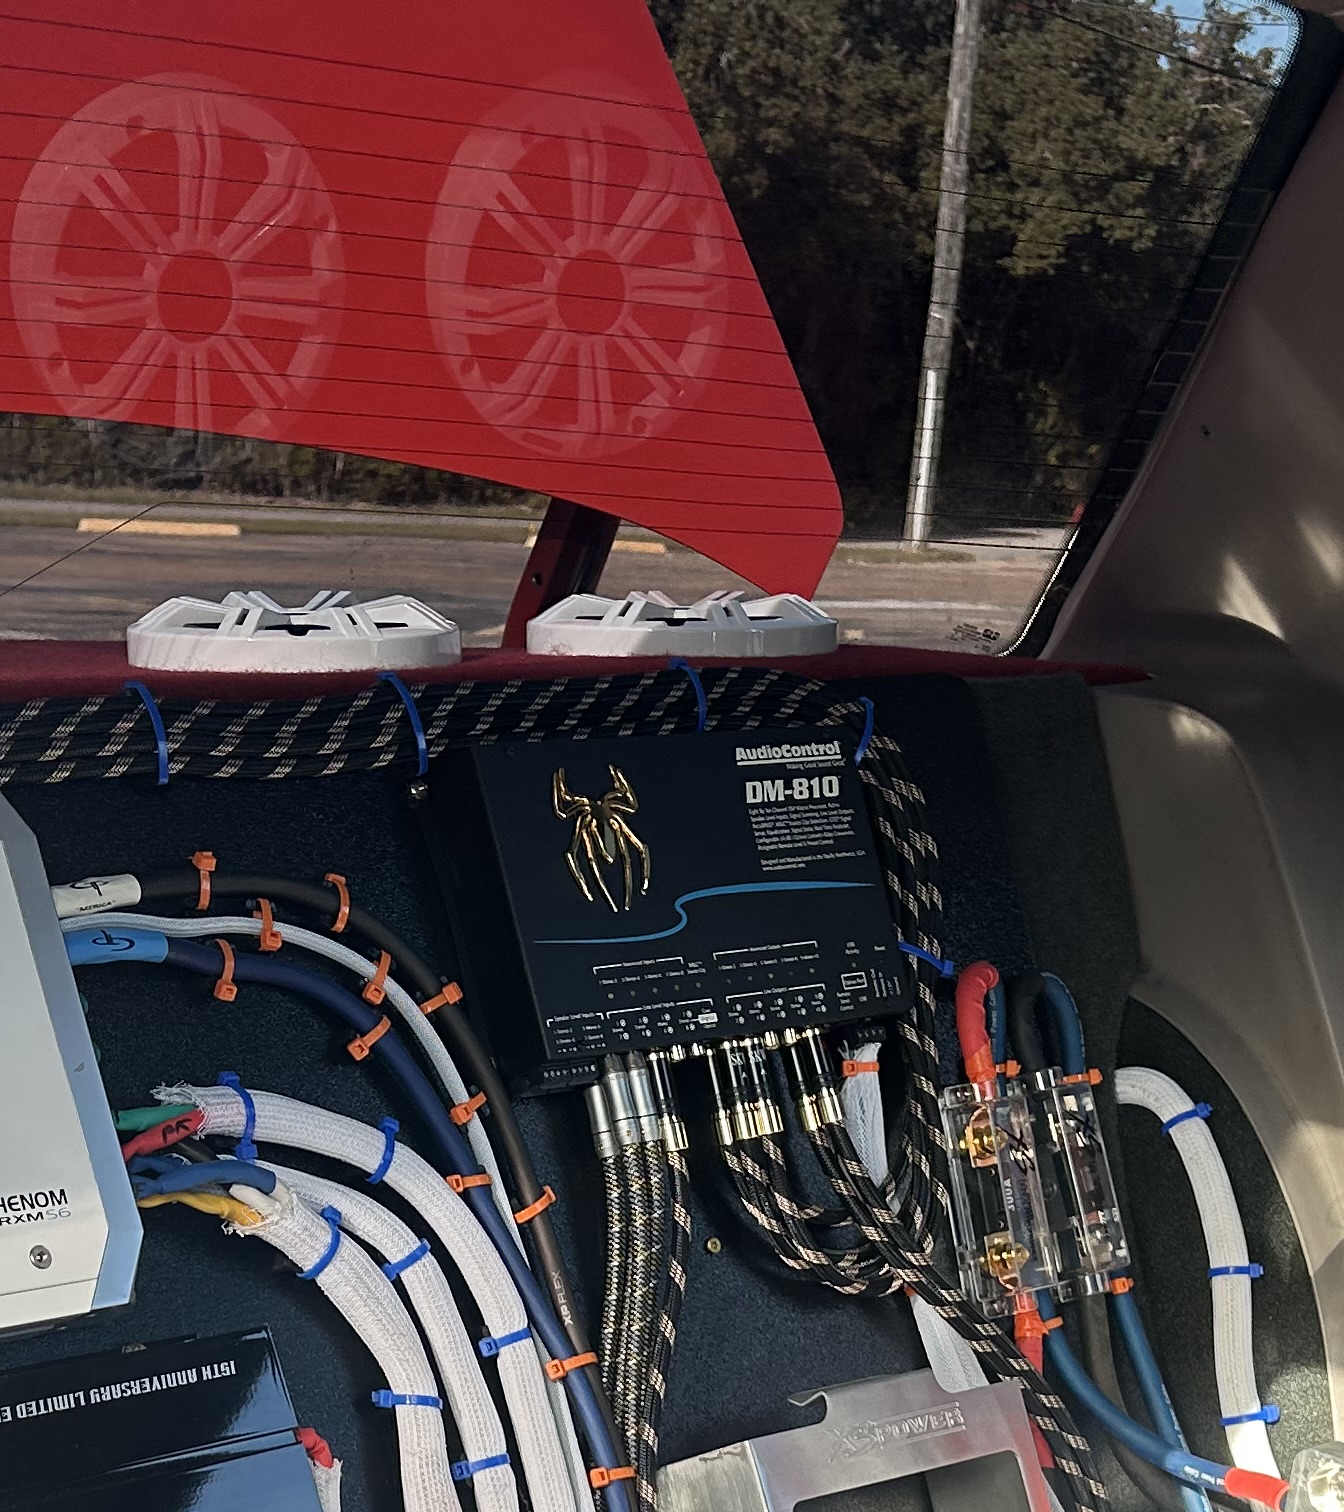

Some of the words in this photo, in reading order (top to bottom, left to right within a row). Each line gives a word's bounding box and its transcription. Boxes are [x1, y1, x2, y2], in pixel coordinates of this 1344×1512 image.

[735, 740, 842, 761] AudioControl
[745, 775, 840, 804] DM-810
[201, 1360, 237, 1382] 15TH
[89, 1367, 198, 1405] ANNIVERSARY
[15, 1389, 86, 1420] LIMITED
